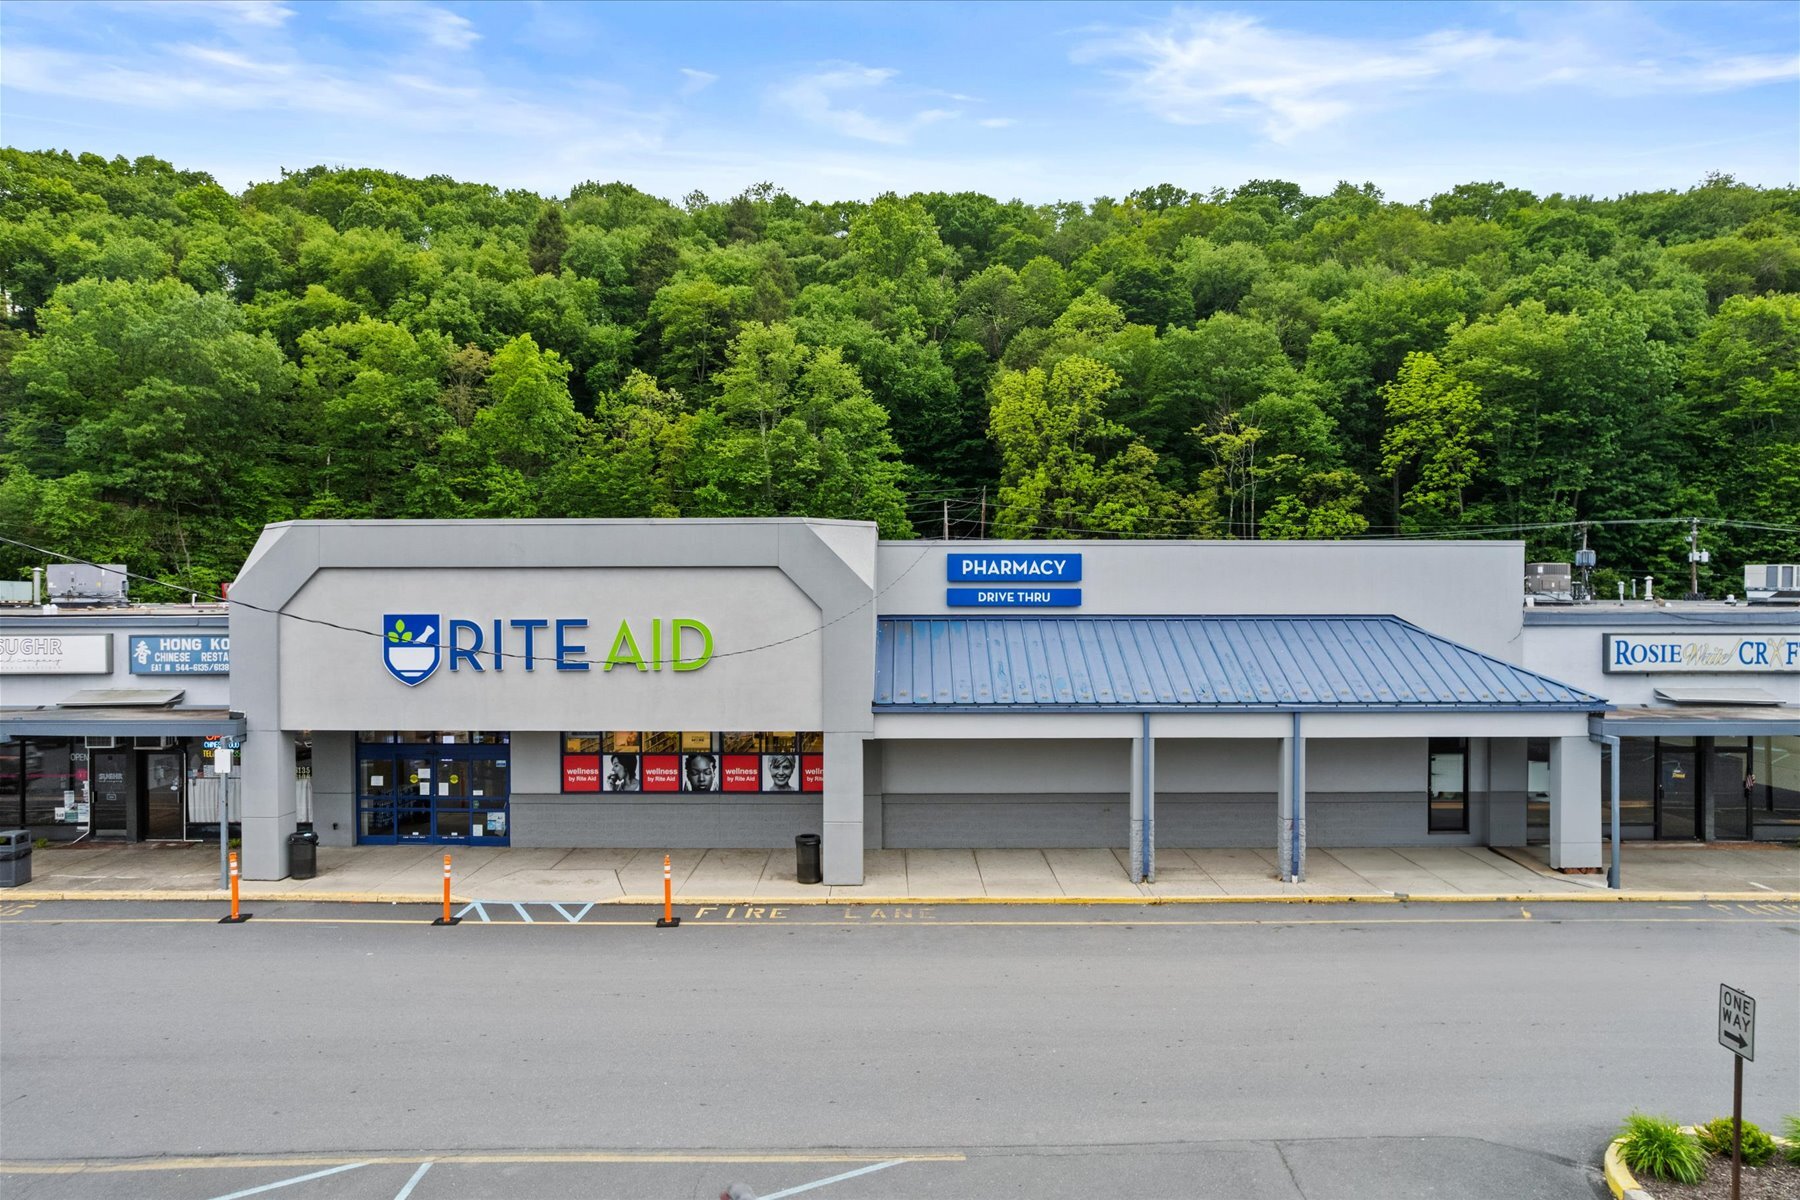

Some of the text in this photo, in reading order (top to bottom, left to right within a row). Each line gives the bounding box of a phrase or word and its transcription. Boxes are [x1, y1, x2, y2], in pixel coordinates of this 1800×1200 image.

[962, 560, 1066, 574] PHARMACY
[978, 592, 1050, 602] DRIVE THRU
[133, 640, 152, 664] 香
[160, 638, 202, 650] HONG
[450, 618, 714, 672] RITE AID
[1614, 640, 1682, 665] ROSIE
[154, 652, 190, 662] CHINESE
[694, 907, 936, 919] FIRE LANE
[1724, 991, 1750, 1016] ONE
[1722, 1007, 1750, 1032] WAY
